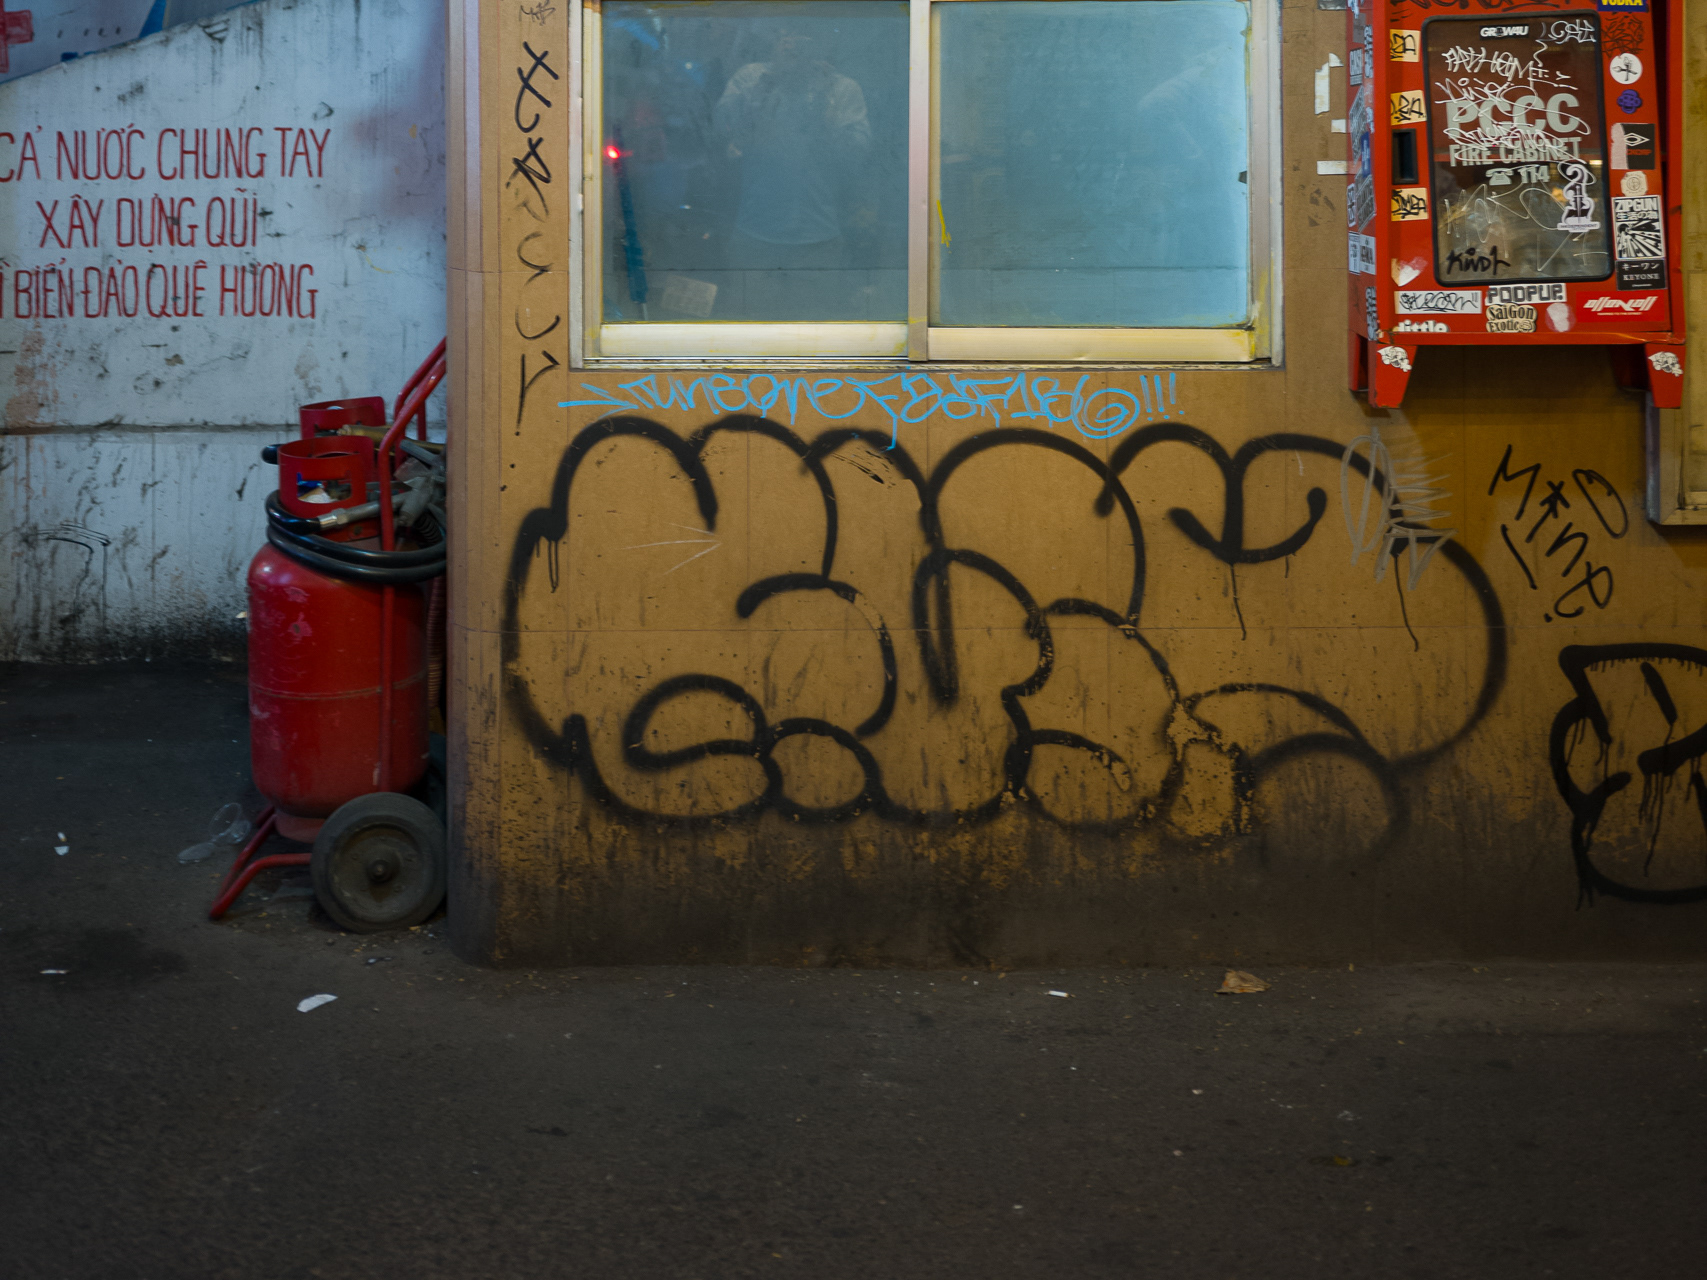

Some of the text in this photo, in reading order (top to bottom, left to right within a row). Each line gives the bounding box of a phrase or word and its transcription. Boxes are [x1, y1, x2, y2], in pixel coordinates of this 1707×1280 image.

[1446, 92, 1581, 140] PCCC
[0, 123, 331, 183] CẢ NƯỚC CHUNG TAY
[1449, 136, 1583, 168] FIRE CABINET
[1518, 166, 1550, 184] 114
[1615, 197, 1658, 213] ZIPGUN
[36, 194, 104, 249] XÂY
[116, 193, 199, 254] DỰNG
[14, 257, 74, 319] BIỂN
[80, 258, 139, 318] ĐẢO
[145, 259, 208, 319] QUÊ
[219, 261, 319, 319] HƯƠNG
[1622, 273, 1661, 282] KEYONE
[1488, 320, 1520, 333] Exotic
